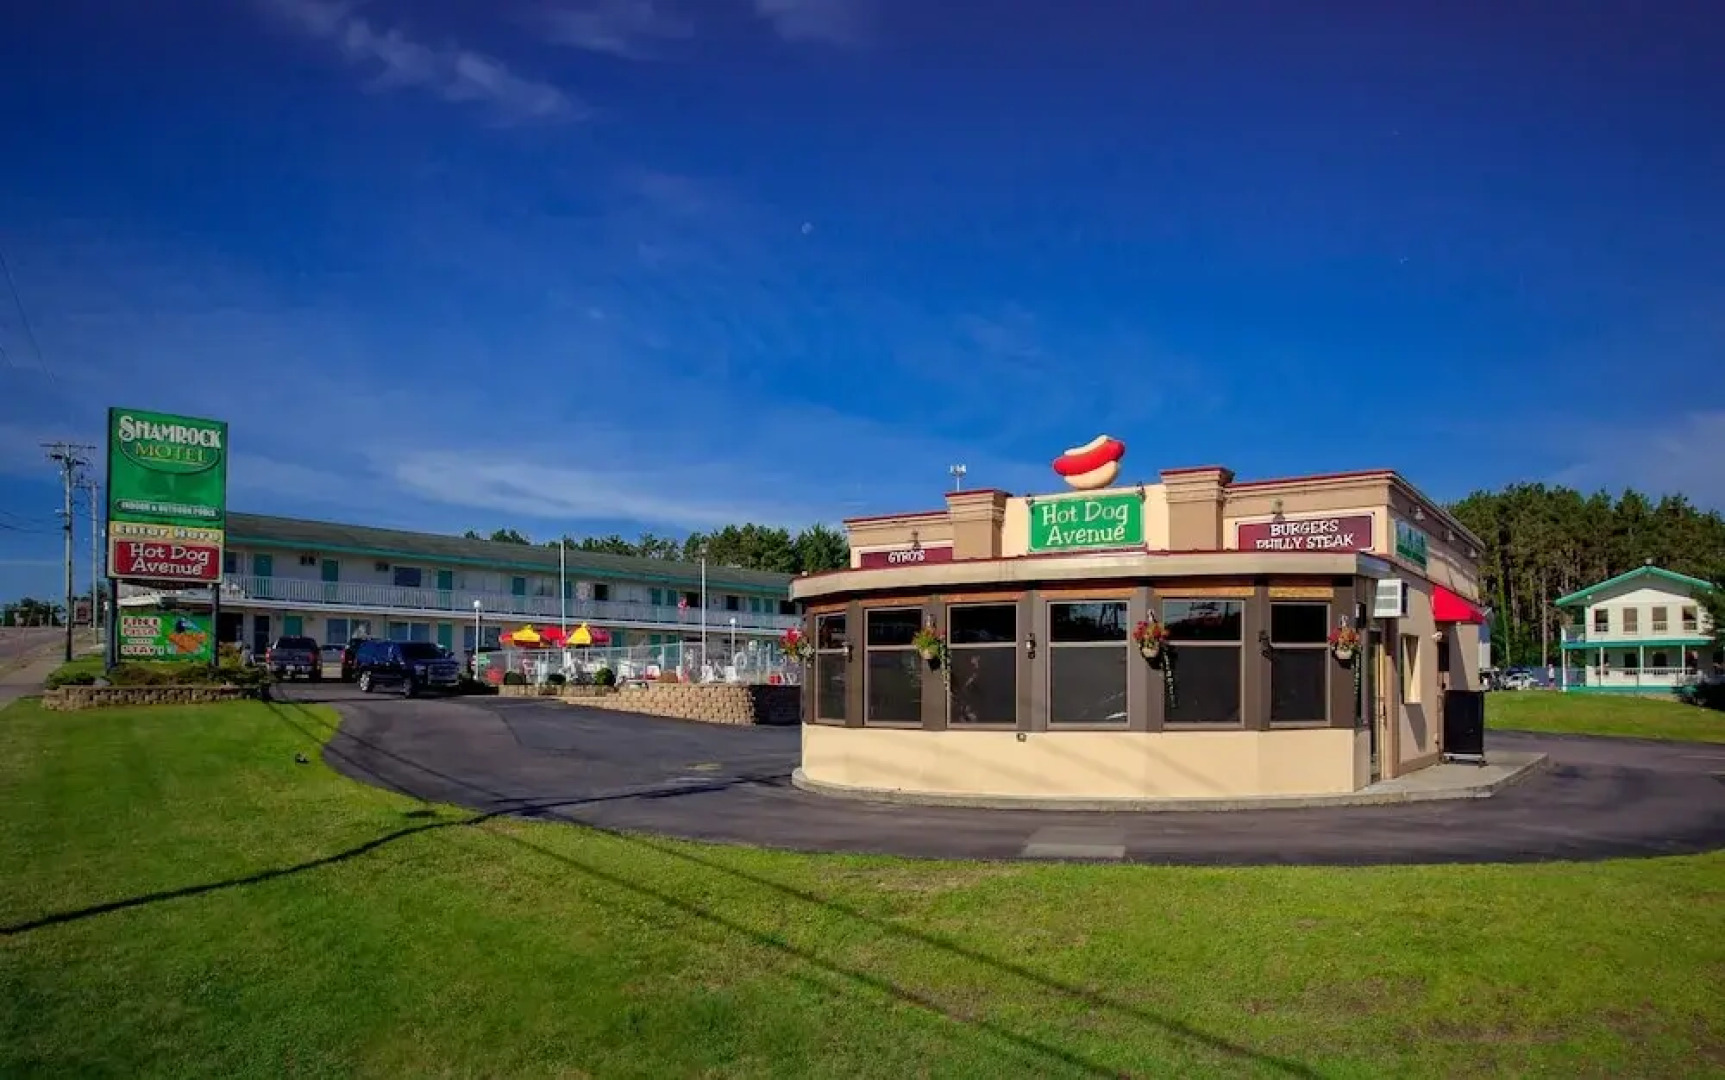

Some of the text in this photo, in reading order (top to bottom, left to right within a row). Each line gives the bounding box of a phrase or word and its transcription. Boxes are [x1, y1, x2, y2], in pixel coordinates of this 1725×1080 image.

[119, 415, 221, 449] SHAMROCK
[135, 442, 205, 462] MOTEL
[1042, 501, 1128, 526] Hot Dog
[1045, 523, 1126, 546] Avenue
[1270, 519, 1340, 537] BURGERS
[1255, 532, 1354, 550] PHILLY STEAK
[129, 543, 210, 566] Hot Dog
[130, 557, 203, 575] Avenue
